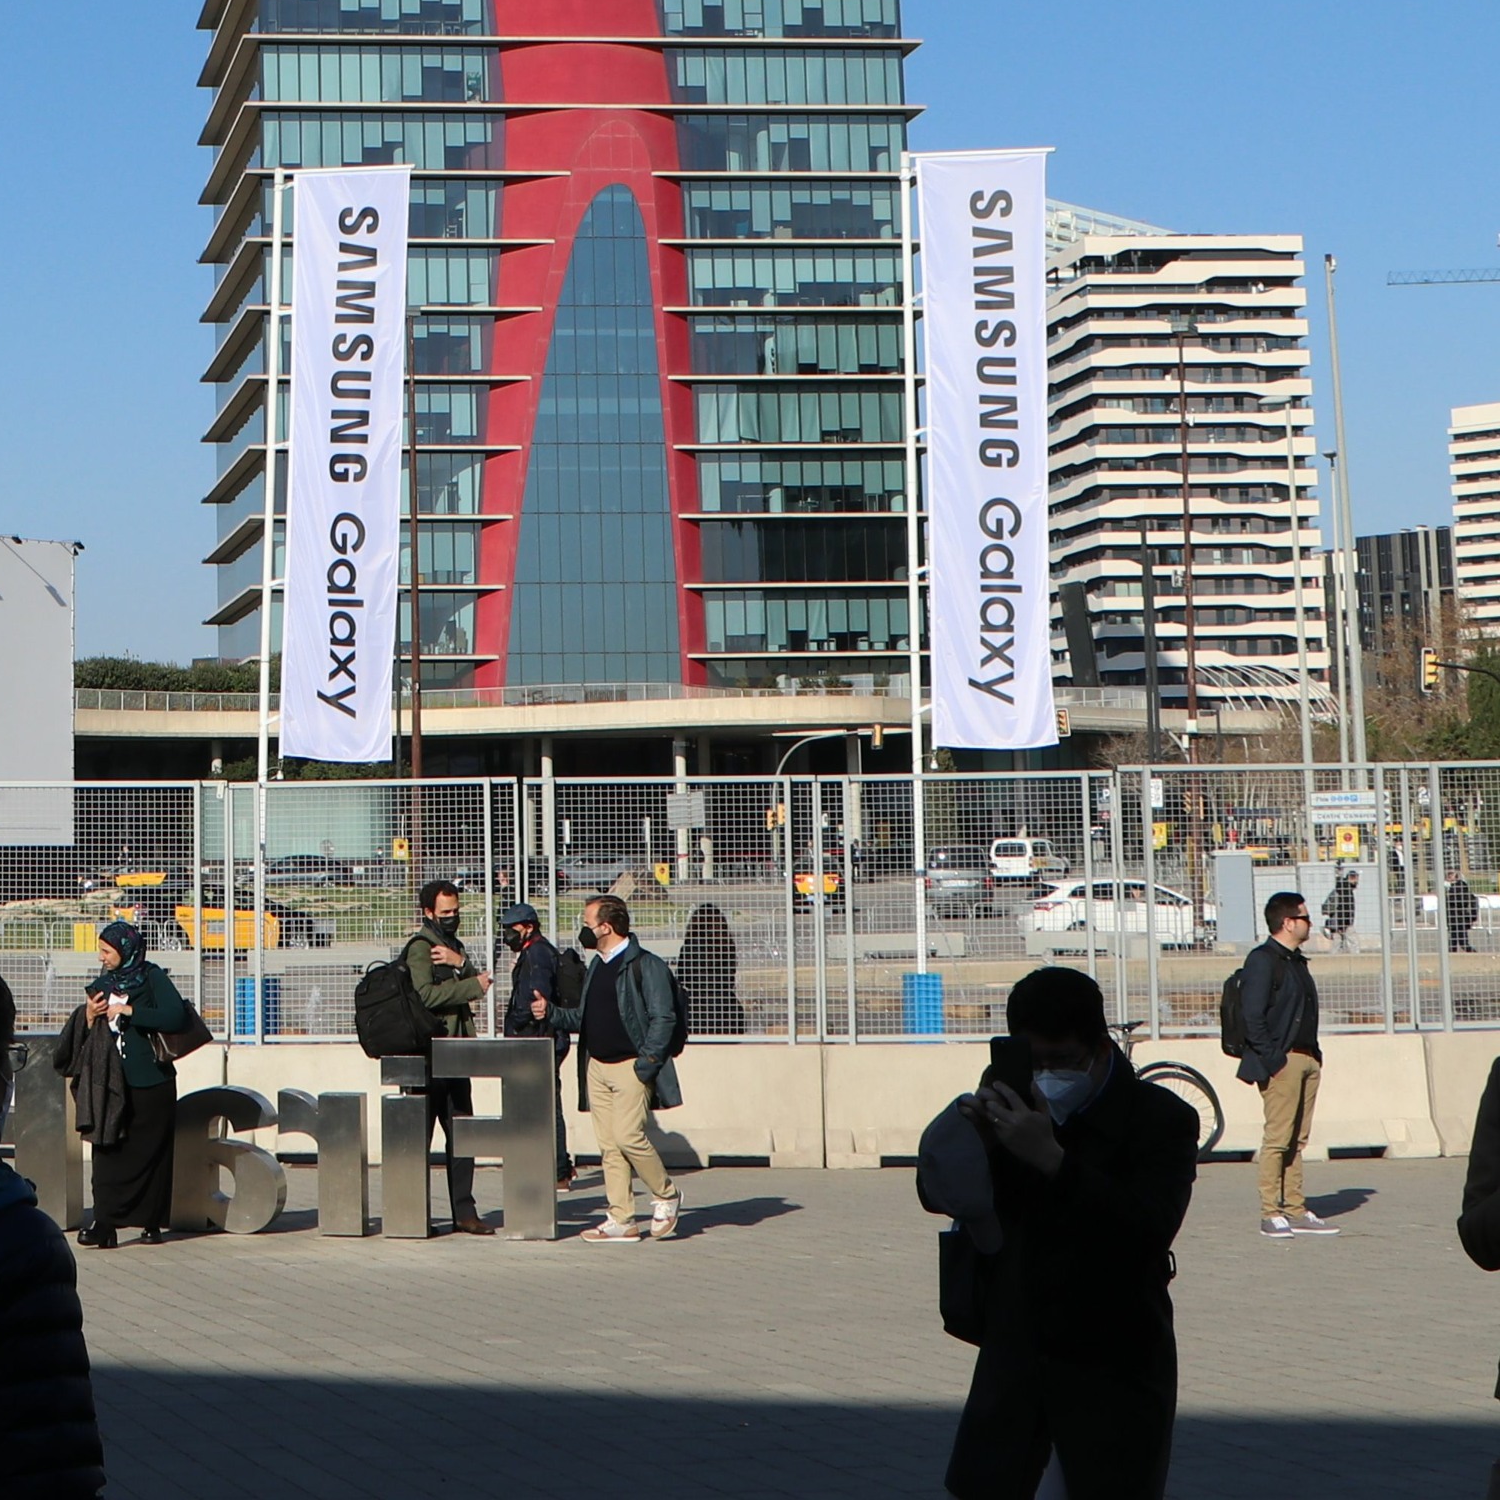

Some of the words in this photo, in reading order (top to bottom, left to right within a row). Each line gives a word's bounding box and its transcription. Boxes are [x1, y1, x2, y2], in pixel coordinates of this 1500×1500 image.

[329, 206, 379, 483] SAMSUNG
[969, 189, 1020, 468] SAMSUNG
[316, 512, 366, 719] Galaxy
[967, 497, 1022, 705] Galaxy
